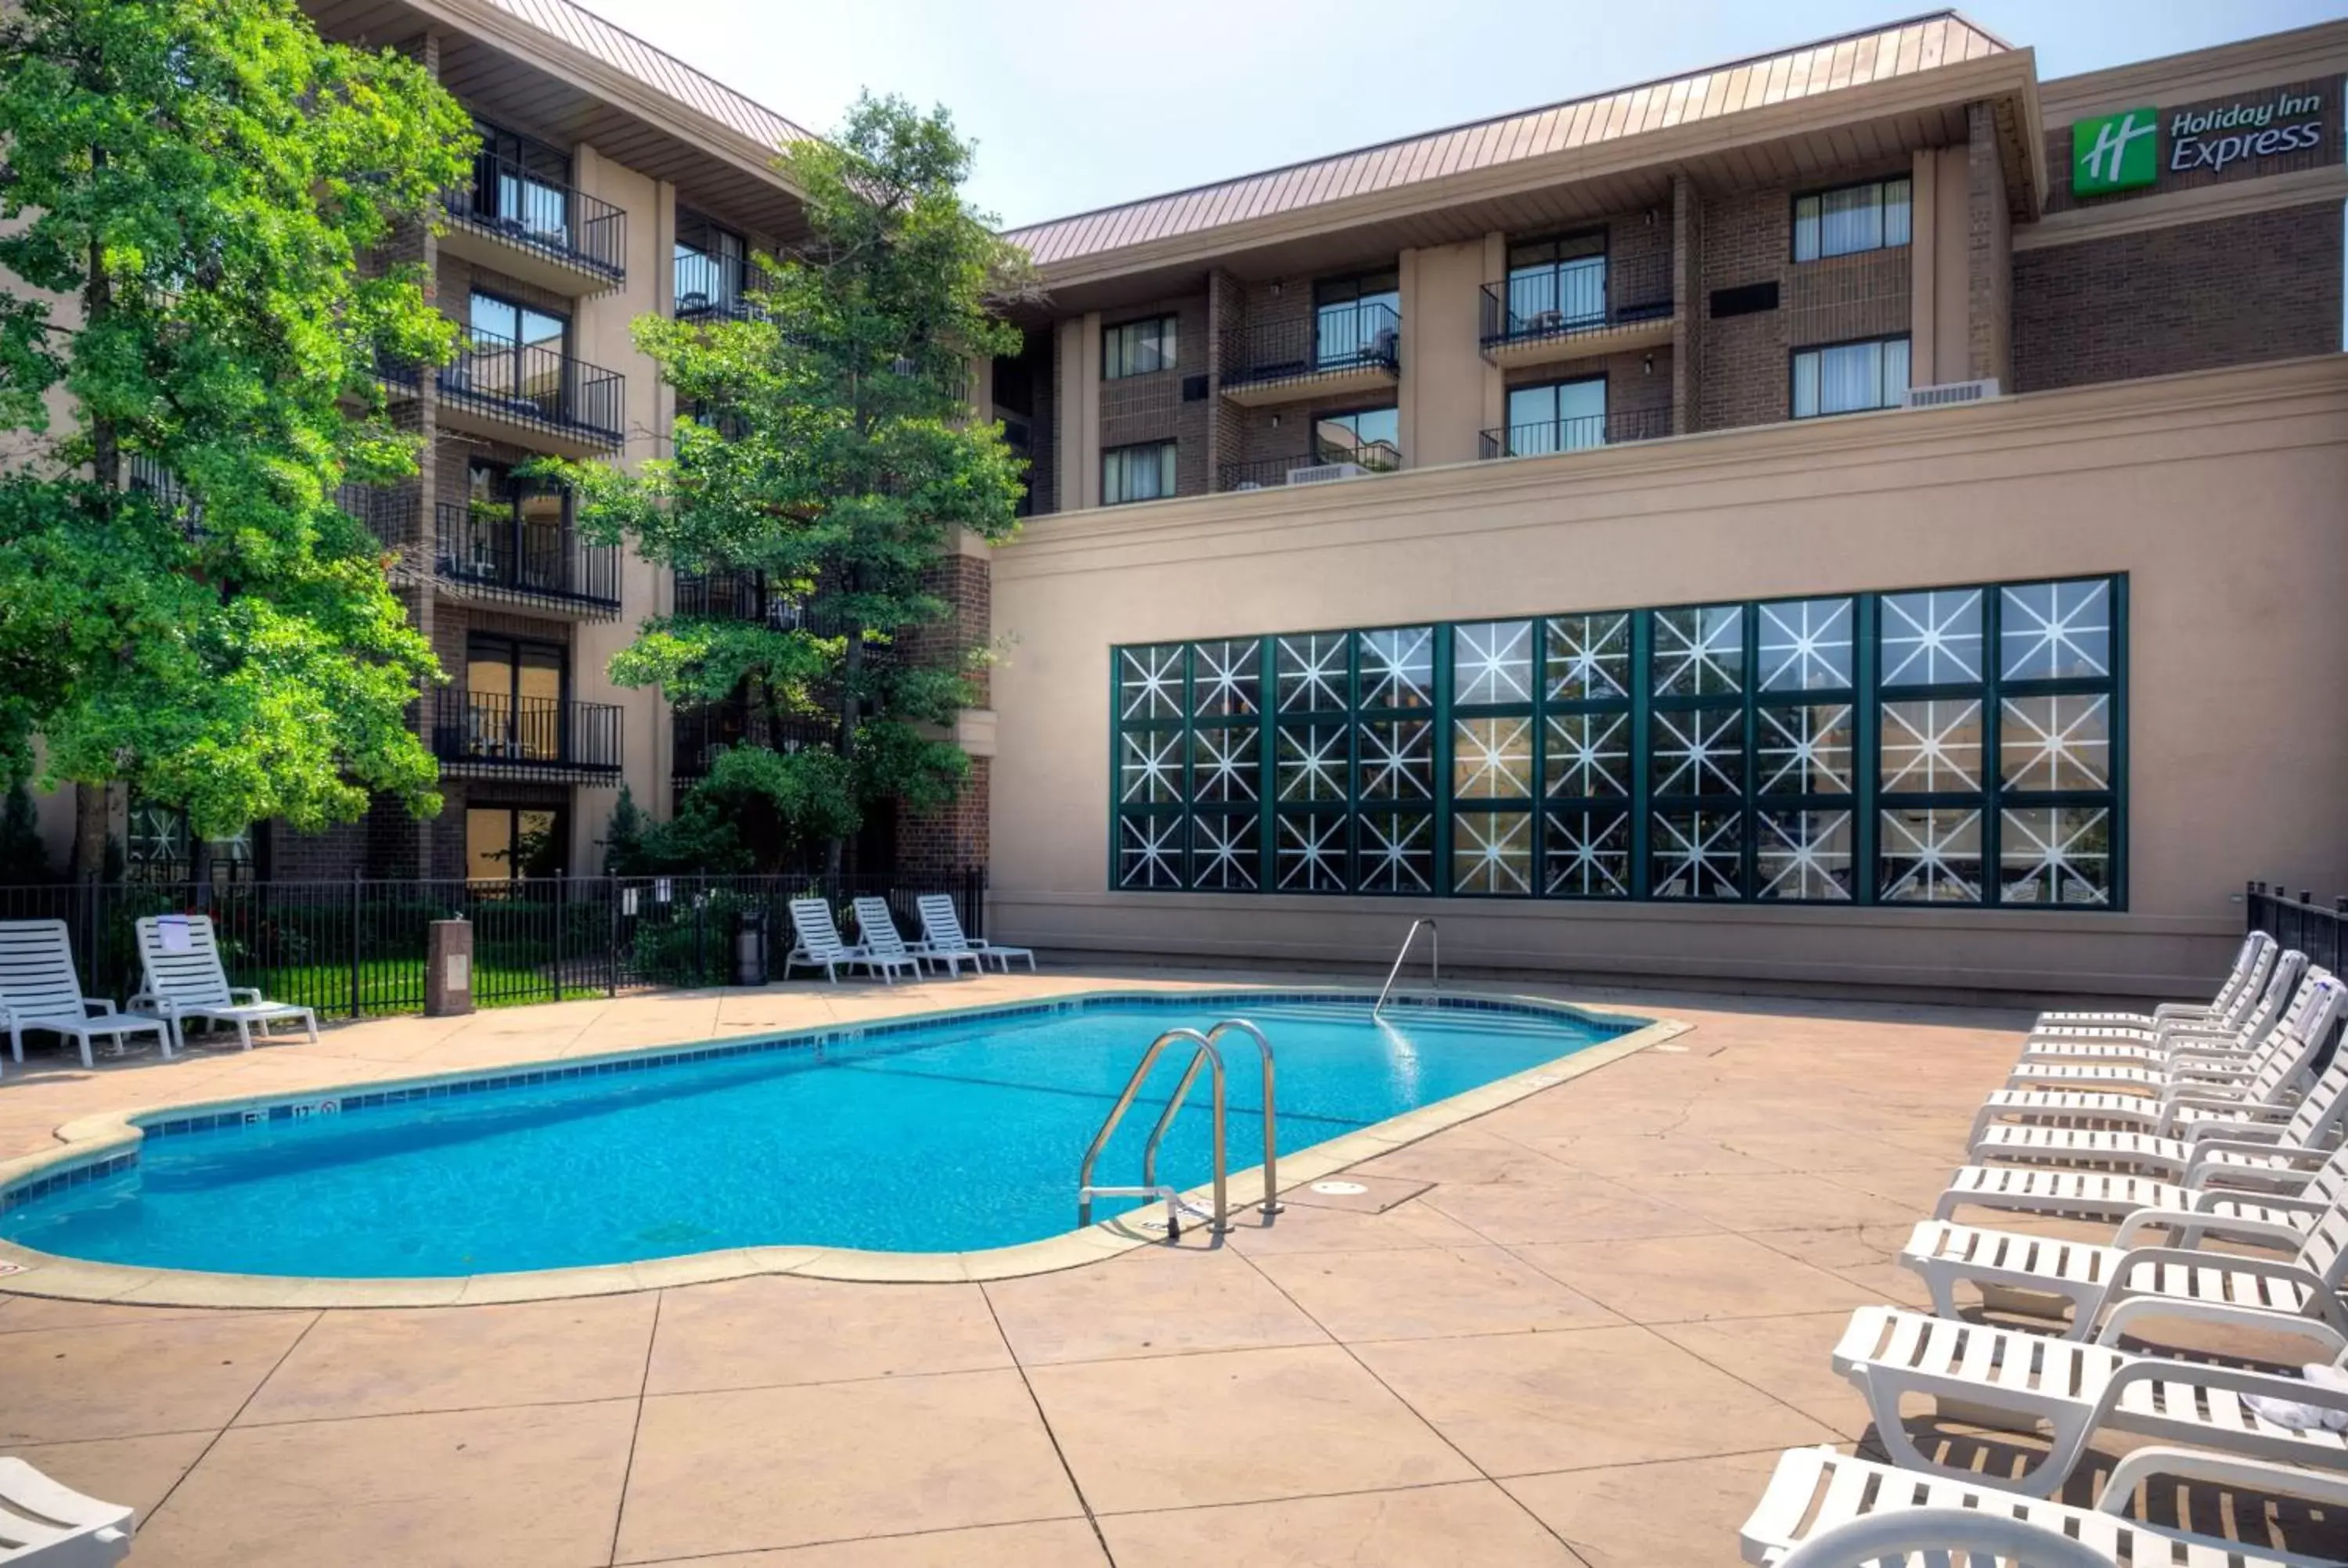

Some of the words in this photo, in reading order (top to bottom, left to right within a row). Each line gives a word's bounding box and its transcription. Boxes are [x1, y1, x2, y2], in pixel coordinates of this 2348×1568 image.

[2170, 103, 2273, 136] Holiday
[2278, 93, 2321, 117] Inn
[2170, 121, 2322, 171] Express
